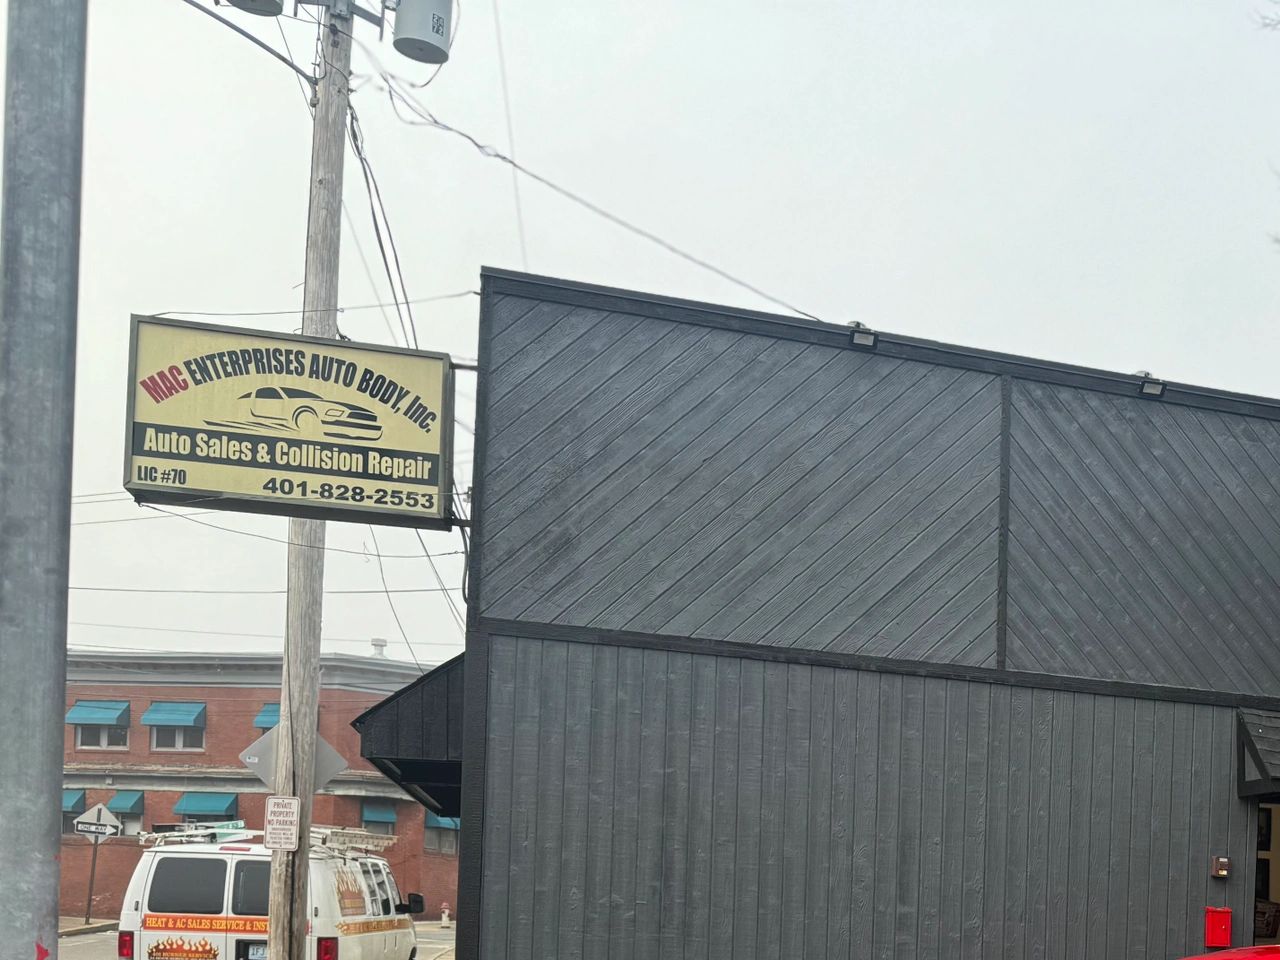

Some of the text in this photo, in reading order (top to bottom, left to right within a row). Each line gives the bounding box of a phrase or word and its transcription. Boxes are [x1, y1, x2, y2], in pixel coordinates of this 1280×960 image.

[139, 347, 437, 434] MAC ENTERPRISES AUTO BODY, Inc.
[143, 427, 432, 480] Auto Sales & Collision Repair
[137, 465, 187, 485] LIC #70
[262, 477, 434, 509] 401-828-2553
[273, 801, 293, 810] PRIVATE
[270, 810, 295, 818] PROPERTY
[276, 819, 297, 827] PARKING
[146, 917, 167, 927] HEAT
[168, 918, 175, 928] &
[175, 919, 187, 928] AC
[187, 920, 211, 929] SALES
[212, 920, 245, 930] SERVICE
[246, 921, 252, 930] &
